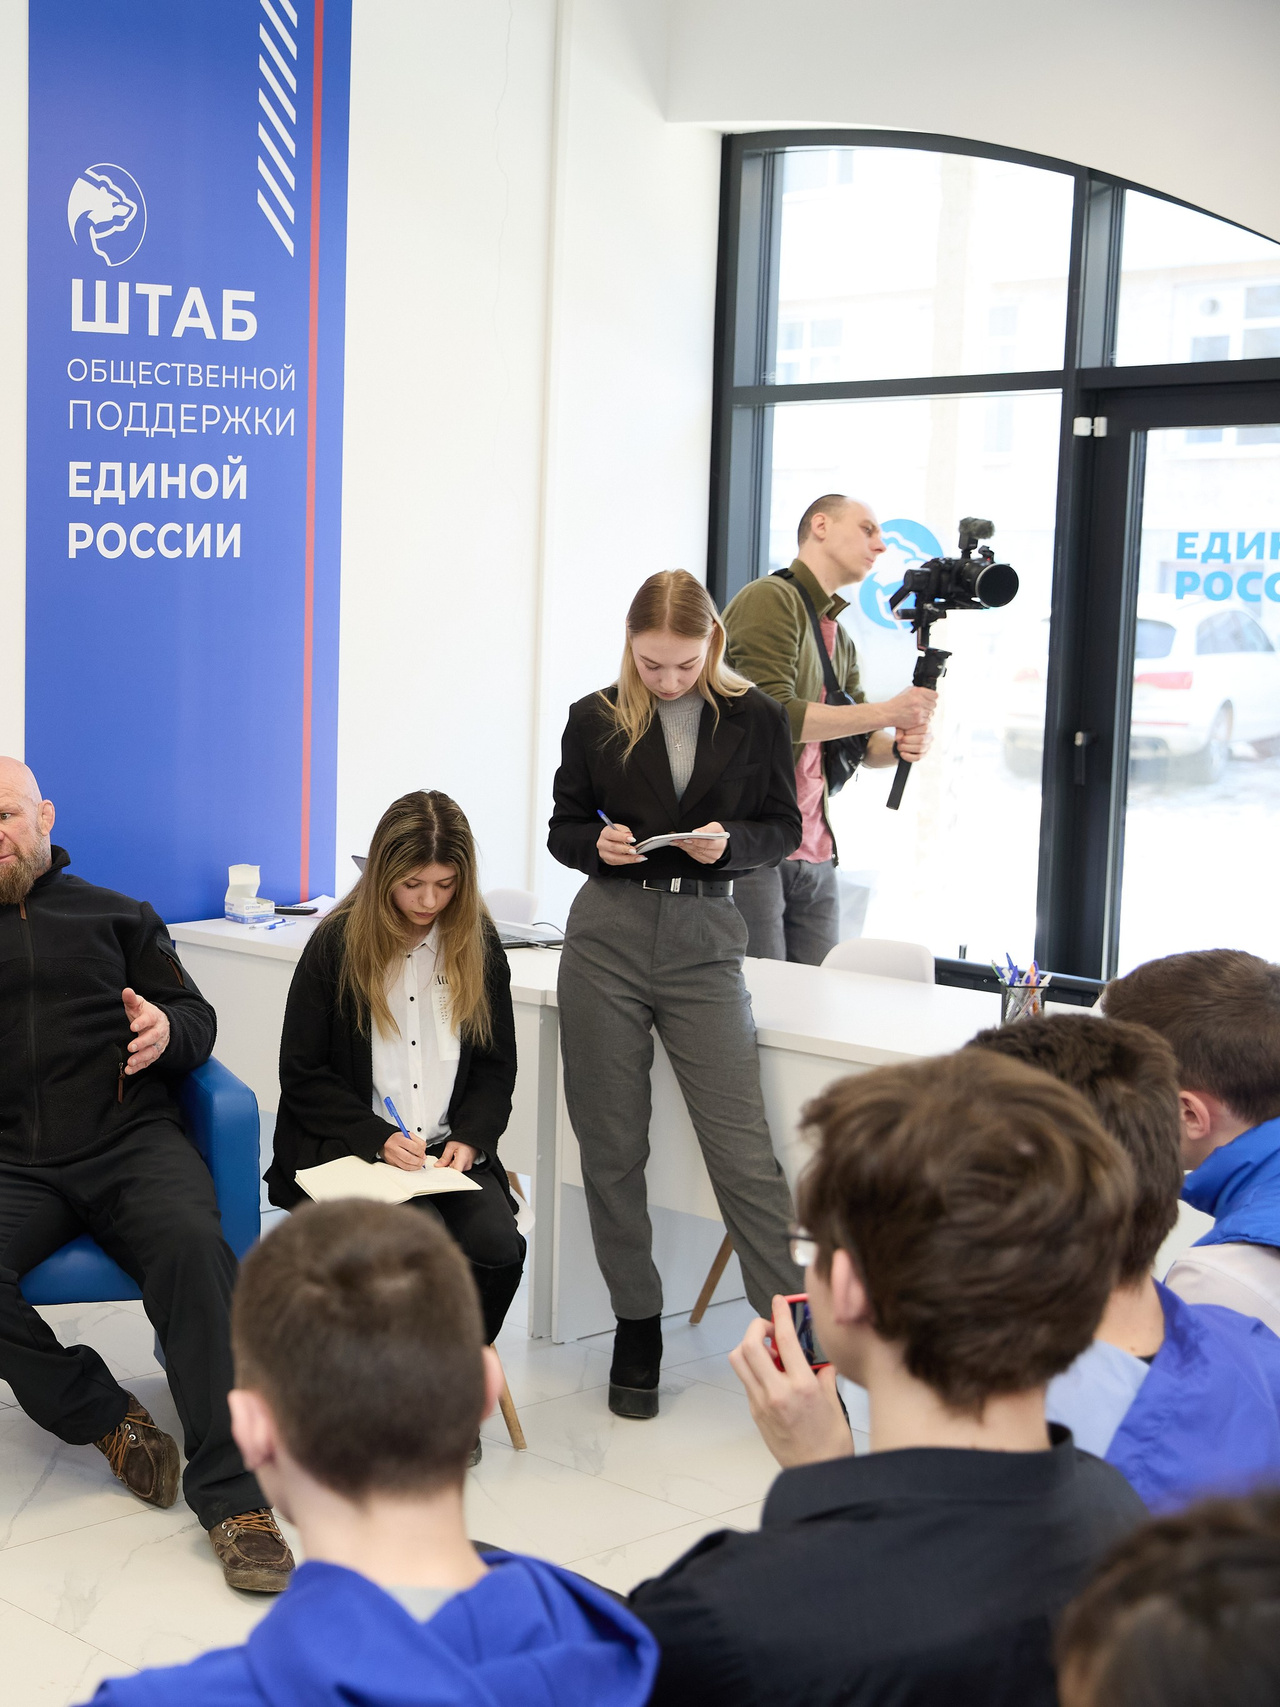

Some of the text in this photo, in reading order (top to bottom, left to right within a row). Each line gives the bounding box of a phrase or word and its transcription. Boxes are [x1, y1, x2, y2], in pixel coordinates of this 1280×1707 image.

[71, 278, 258, 341] ШТАБ
[67, 357, 296, 391] ОБЩЕСТВЕННОЙ
[69, 399, 295, 438] ПОДДЕРЖКИ
[69, 455, 248, 505] ЕДИНОЙ
[68, 522, 241, 559] РОССИИ
